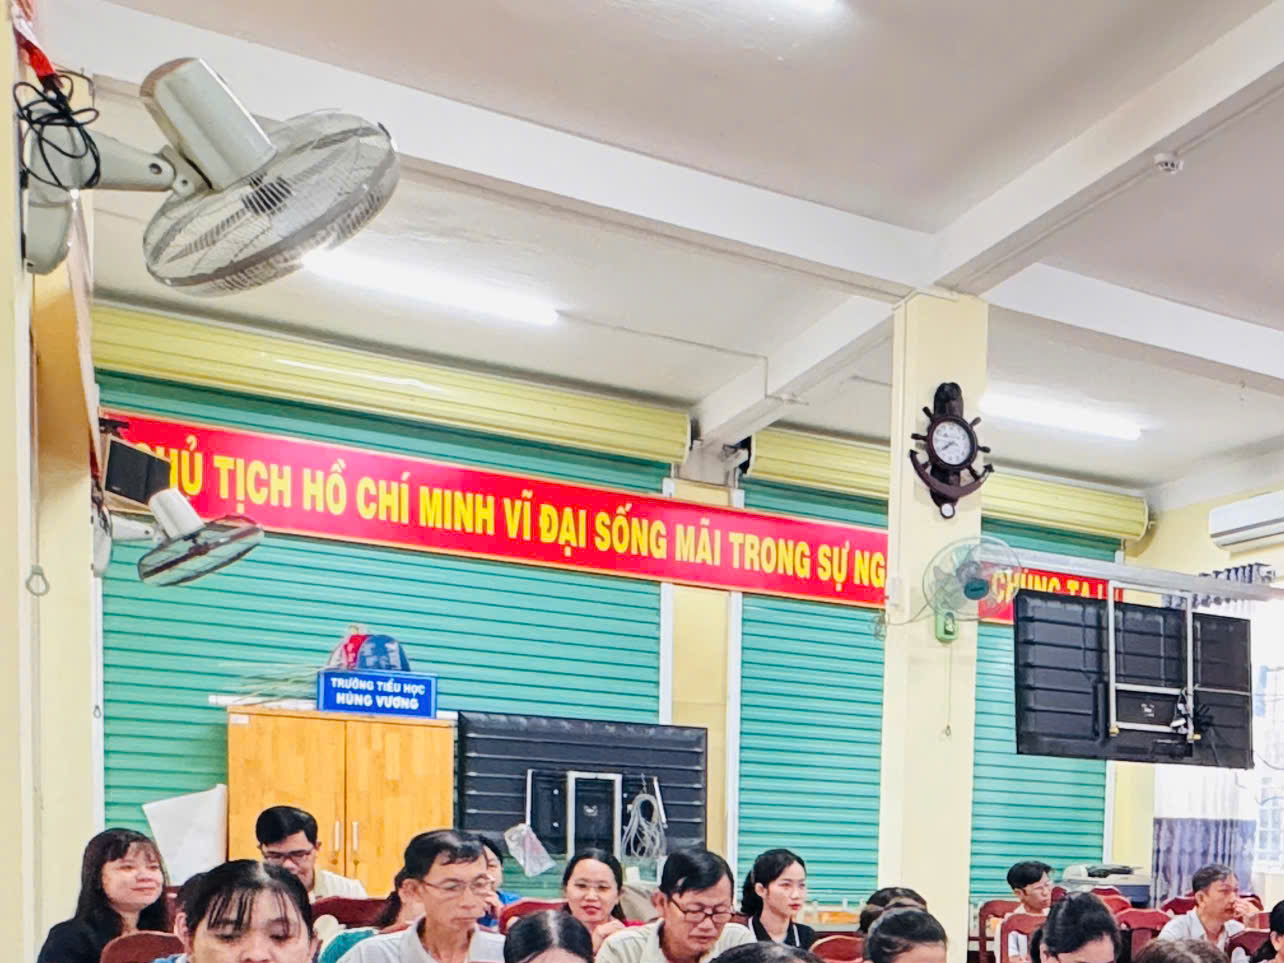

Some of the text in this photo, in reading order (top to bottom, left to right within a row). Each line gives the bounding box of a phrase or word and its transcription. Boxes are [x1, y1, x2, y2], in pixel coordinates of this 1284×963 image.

[213, 455, 292, 513] TỊCH
[303, 458, 348, 517] HỒ
[356, 471, 409, 524] CHÍ
[419, 486, 495, 535] MINH
[503, 490, 532, 541] VĨ
[539, 503, 587, 557] ĐẠI
[595, 503, 668, 560] SỐNG
[674, 518, 721, 565] MÃI
[729, 533, 811, 579] TRONG
[818, 542, 850, 590] SỰ
[403, 683, 425, 697] HỌC
[336, 691, 372, 707] HÙNG
